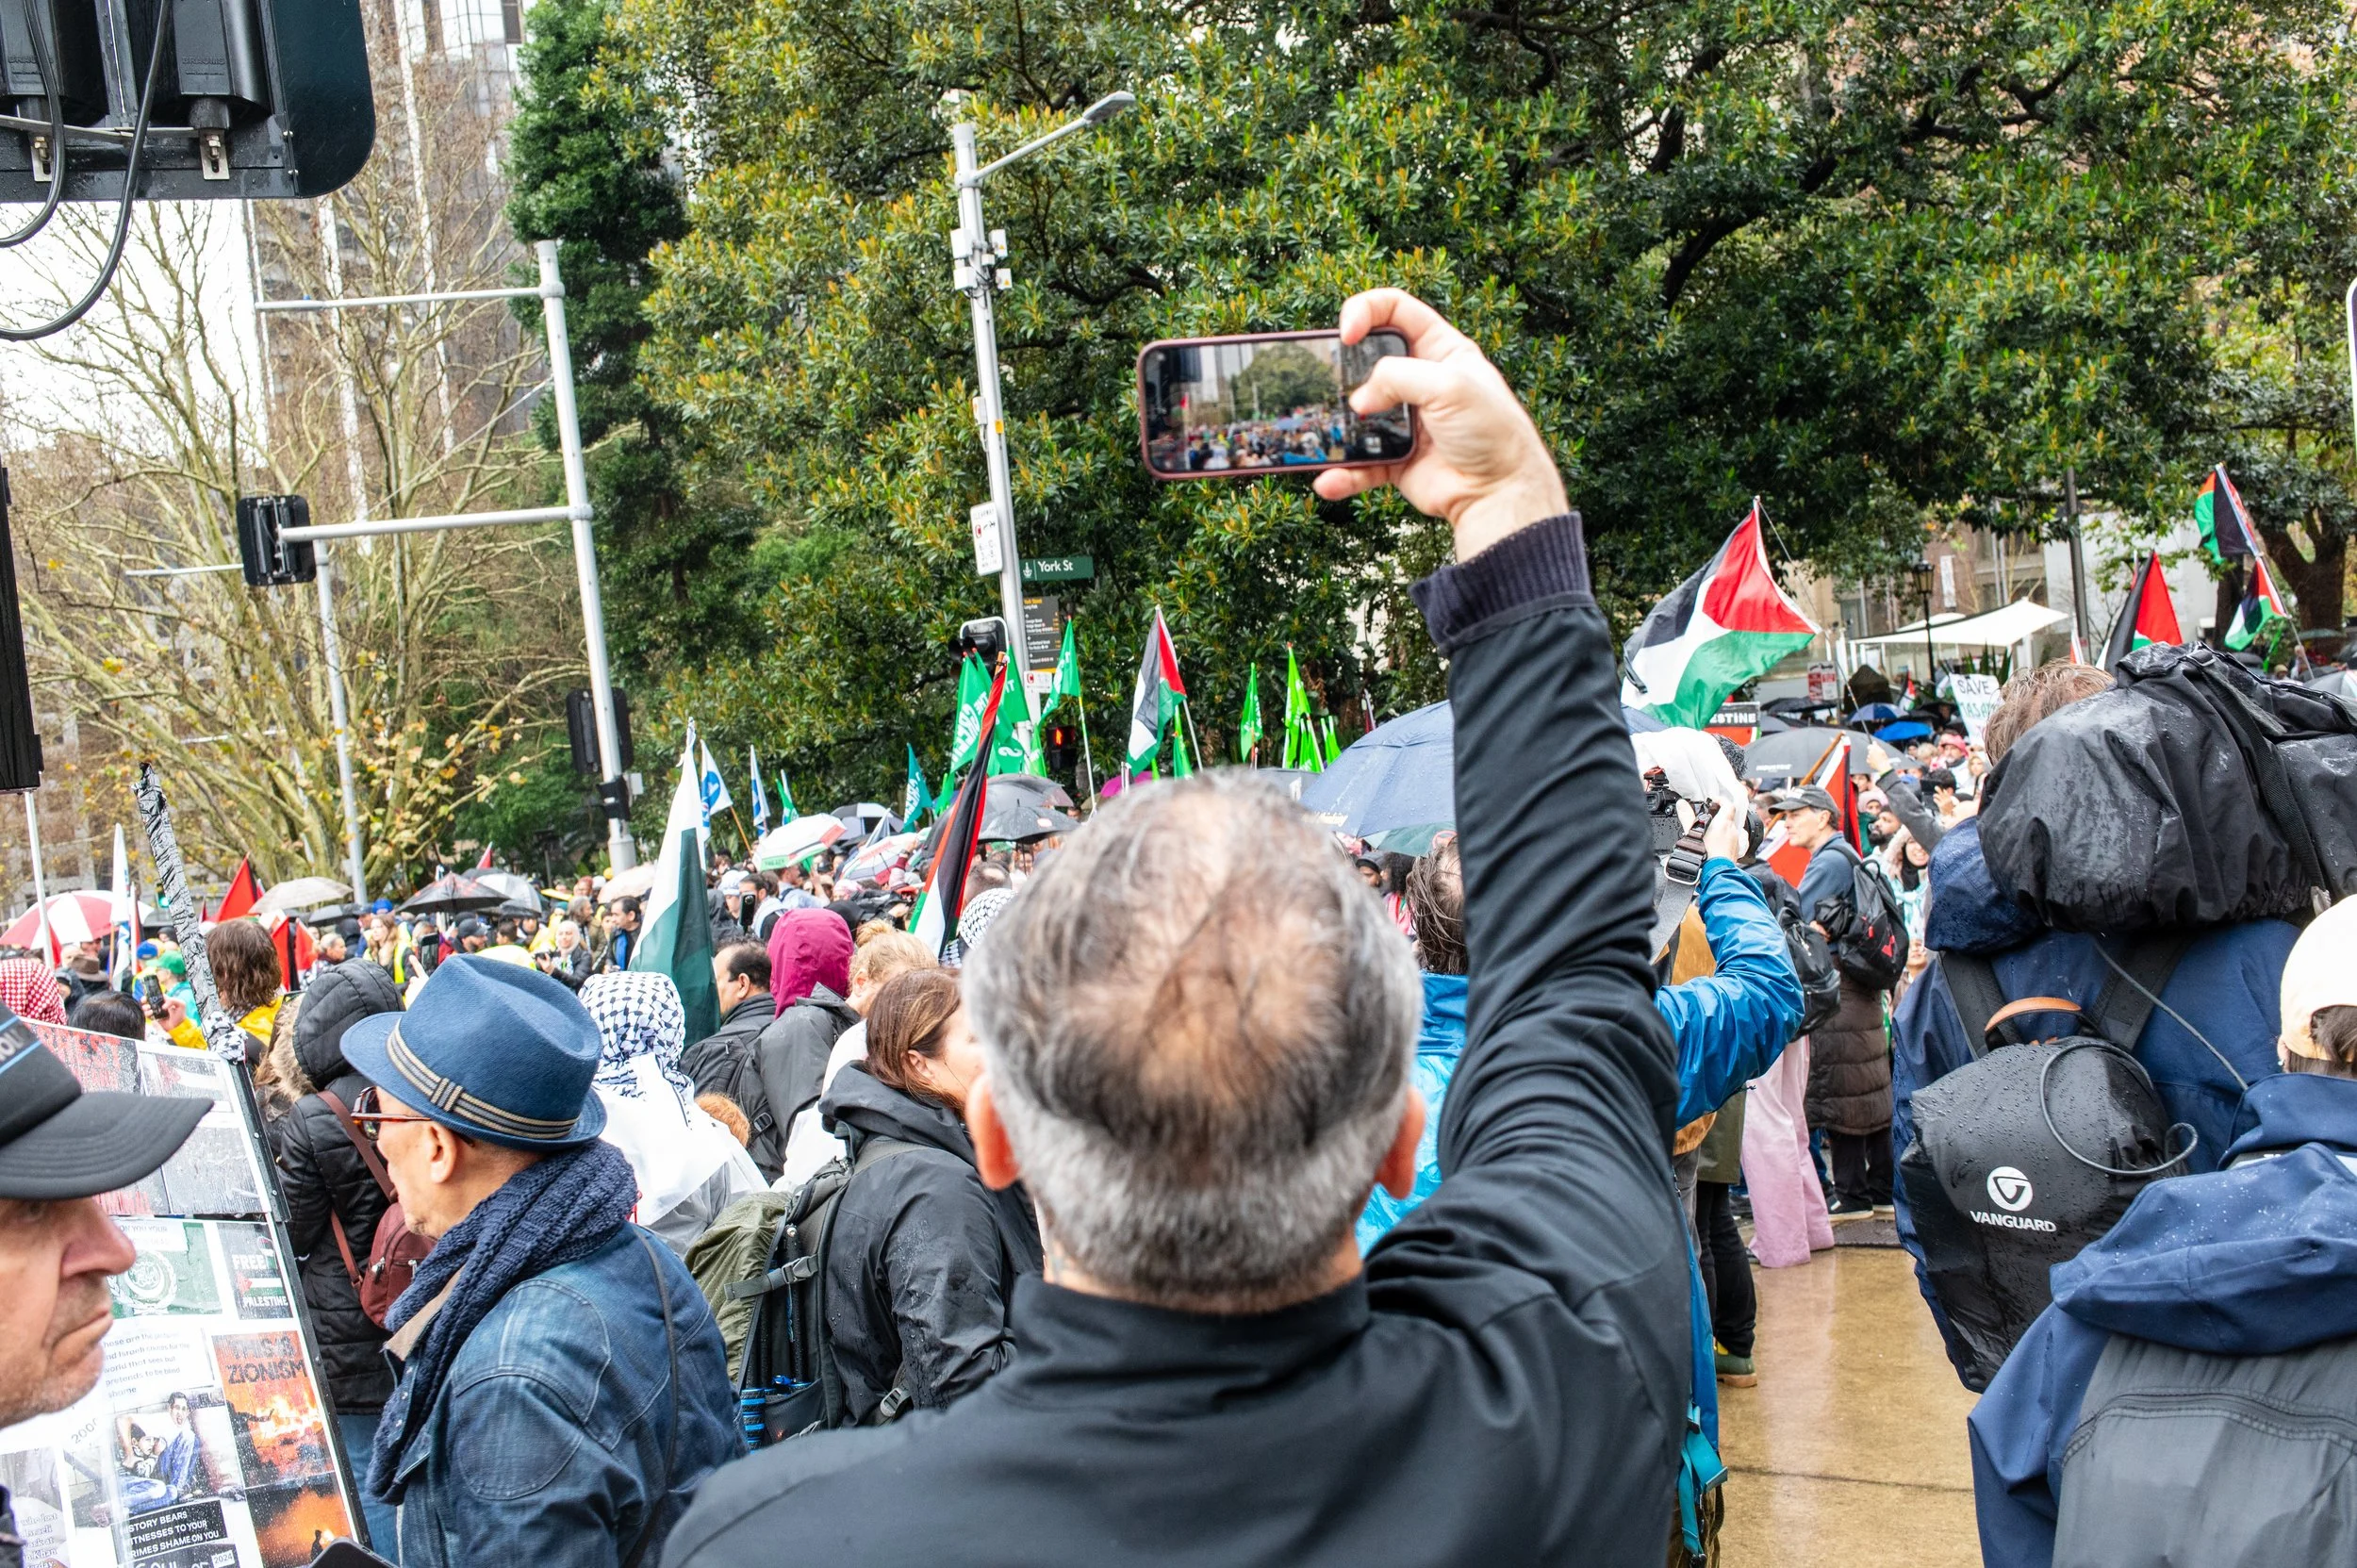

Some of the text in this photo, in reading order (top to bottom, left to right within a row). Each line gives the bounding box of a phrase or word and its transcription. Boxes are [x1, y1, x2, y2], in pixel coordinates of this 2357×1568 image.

[1038, 559, 1074, 572] York St
[1957, 679, 1990, 695] SAVE
[1708, 712, 1756, 724] ESTINE
[1969, 1210, 2057, 1232] VANGUARD
[231, 1254, 267, 1270] FREE
[241, 1296, 288, 1309] PALESTINE
[119, 1346, 145, 1358] Israeli
[226, 1359, 308, 1384] ZIONISM
[159, 1510, 188, 1525] BEARS
[131, 1519, 208, 1545] ITNESSES TO YOUR
[131, 1529, 220, 1559] RIMES SHAME ON YOU
[213, 1552, 233, 1564] 2024
